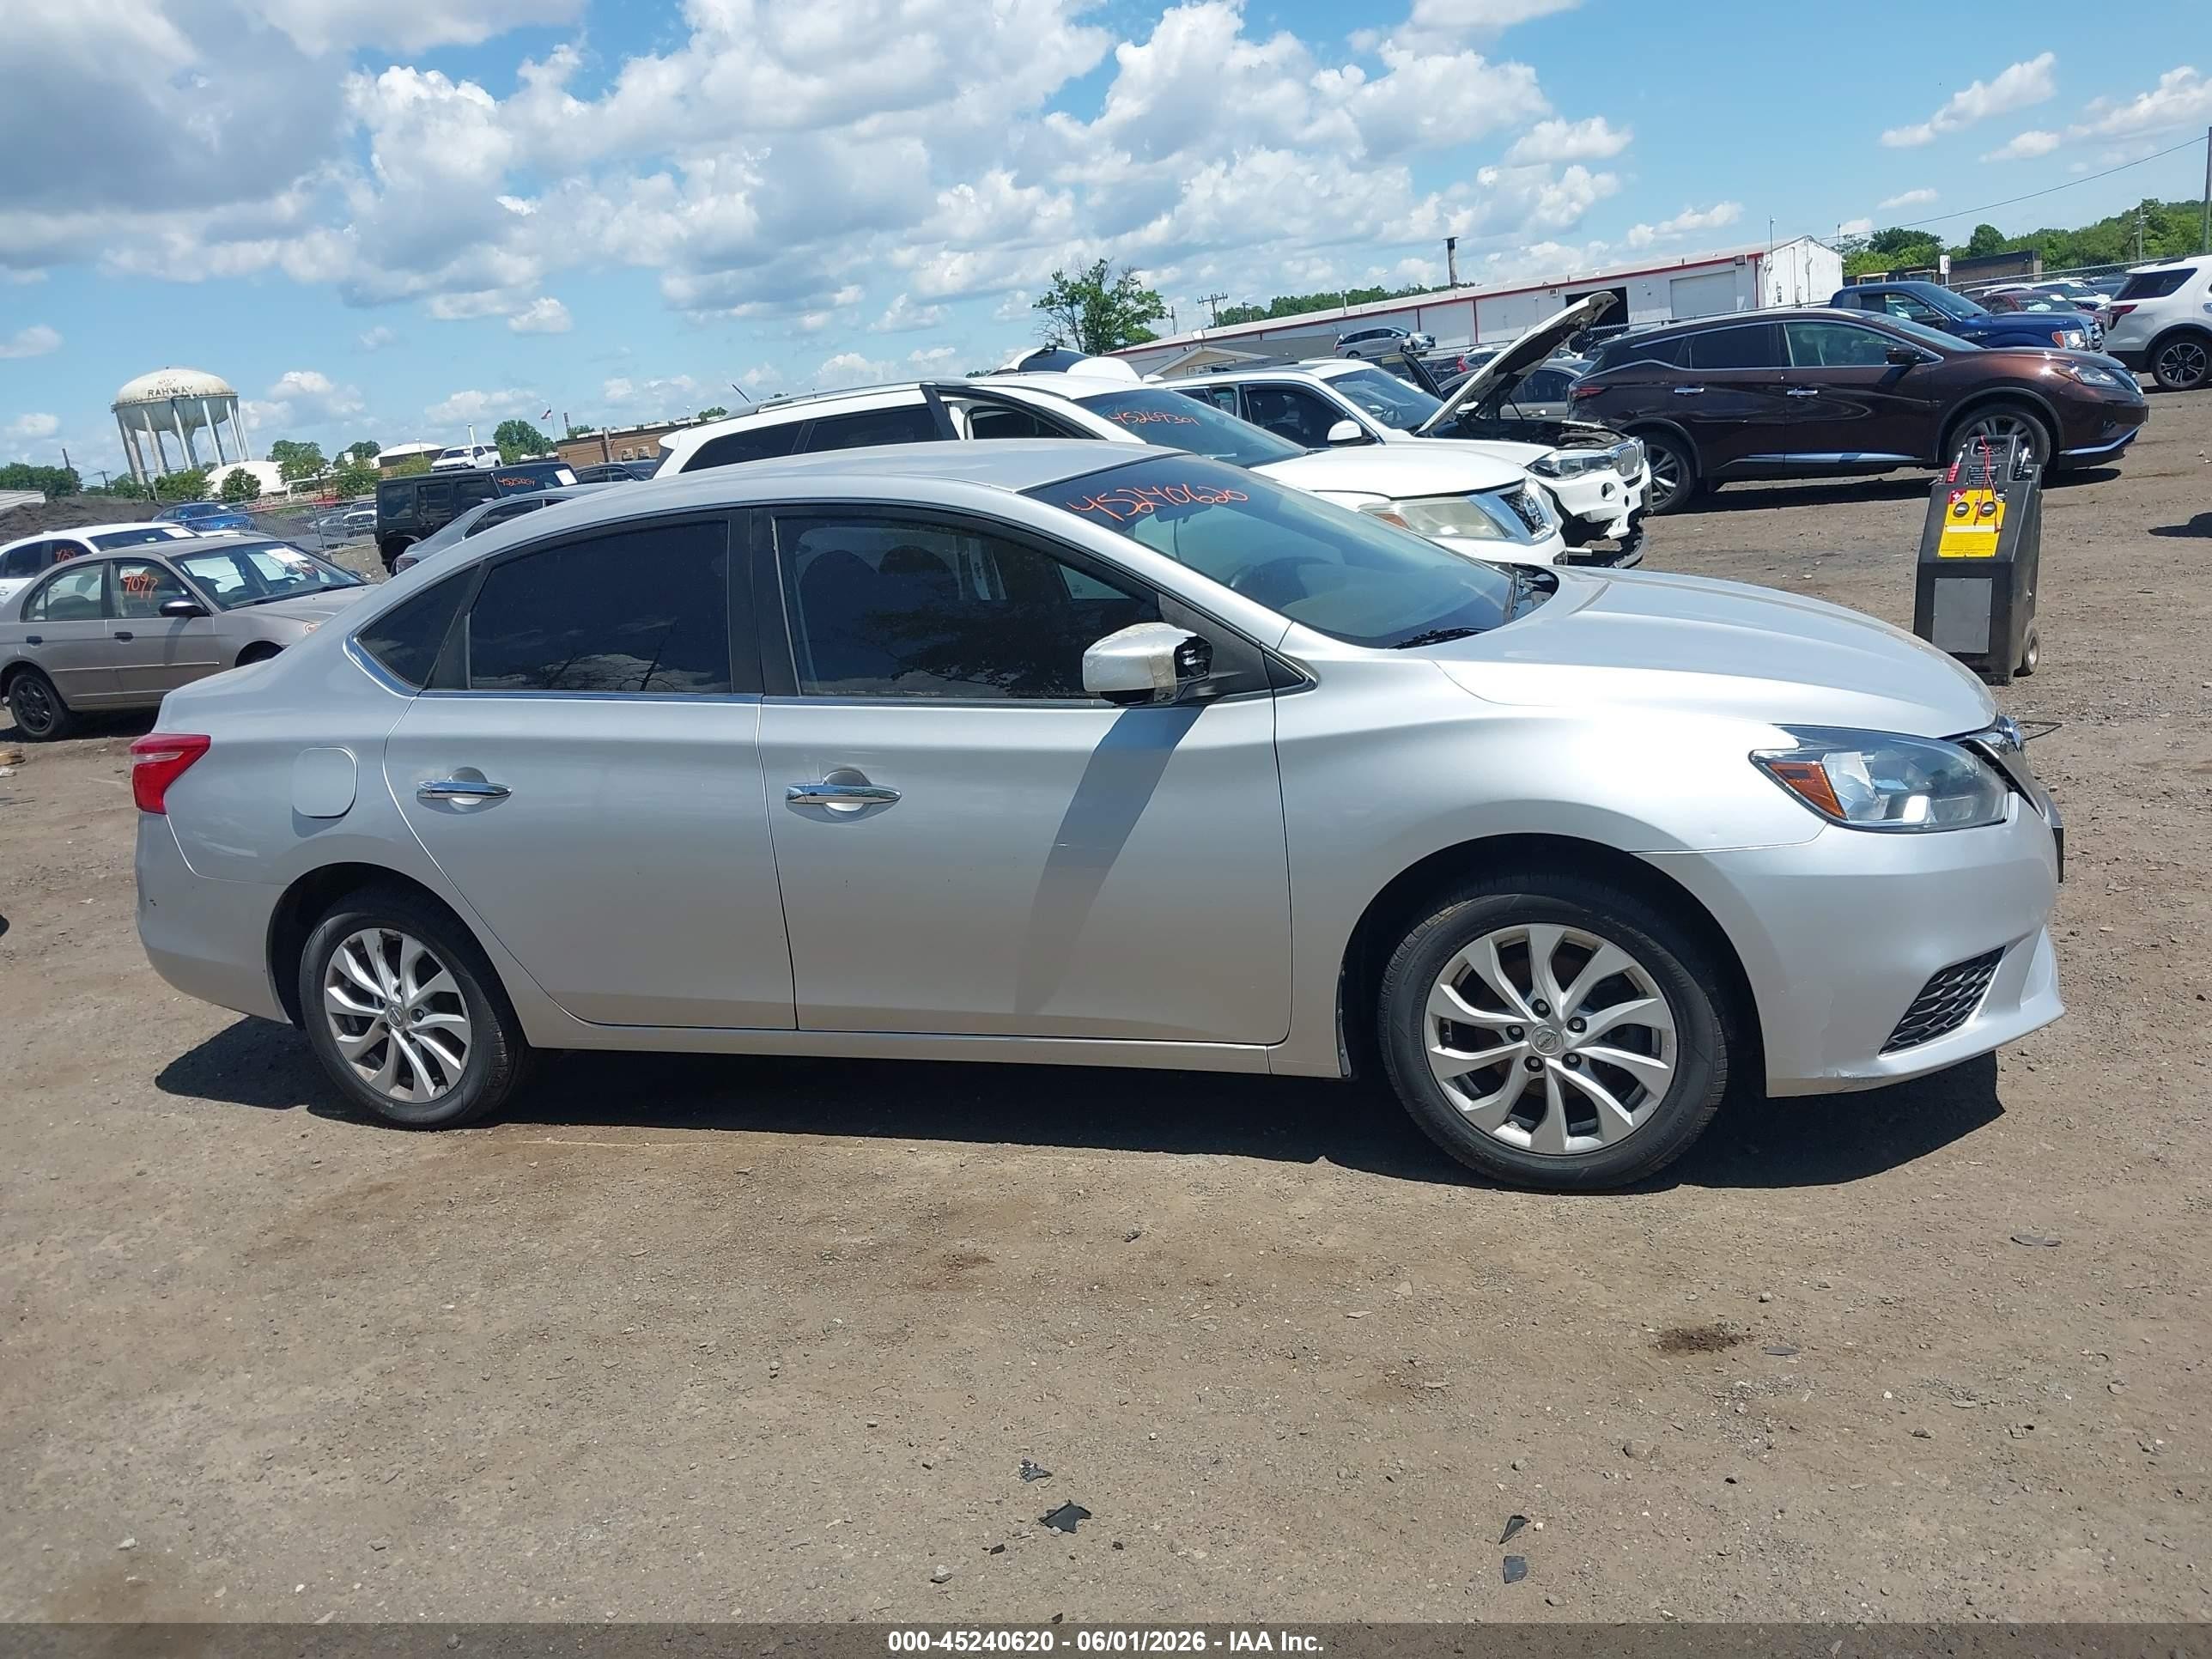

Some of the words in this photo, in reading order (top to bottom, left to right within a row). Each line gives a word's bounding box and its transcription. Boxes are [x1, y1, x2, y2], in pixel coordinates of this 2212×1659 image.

[148, 386, 192, 397] RAHWAY
[1066, 483, 1249, 522] 45240620
[123, 570, 159, 599] 9097
